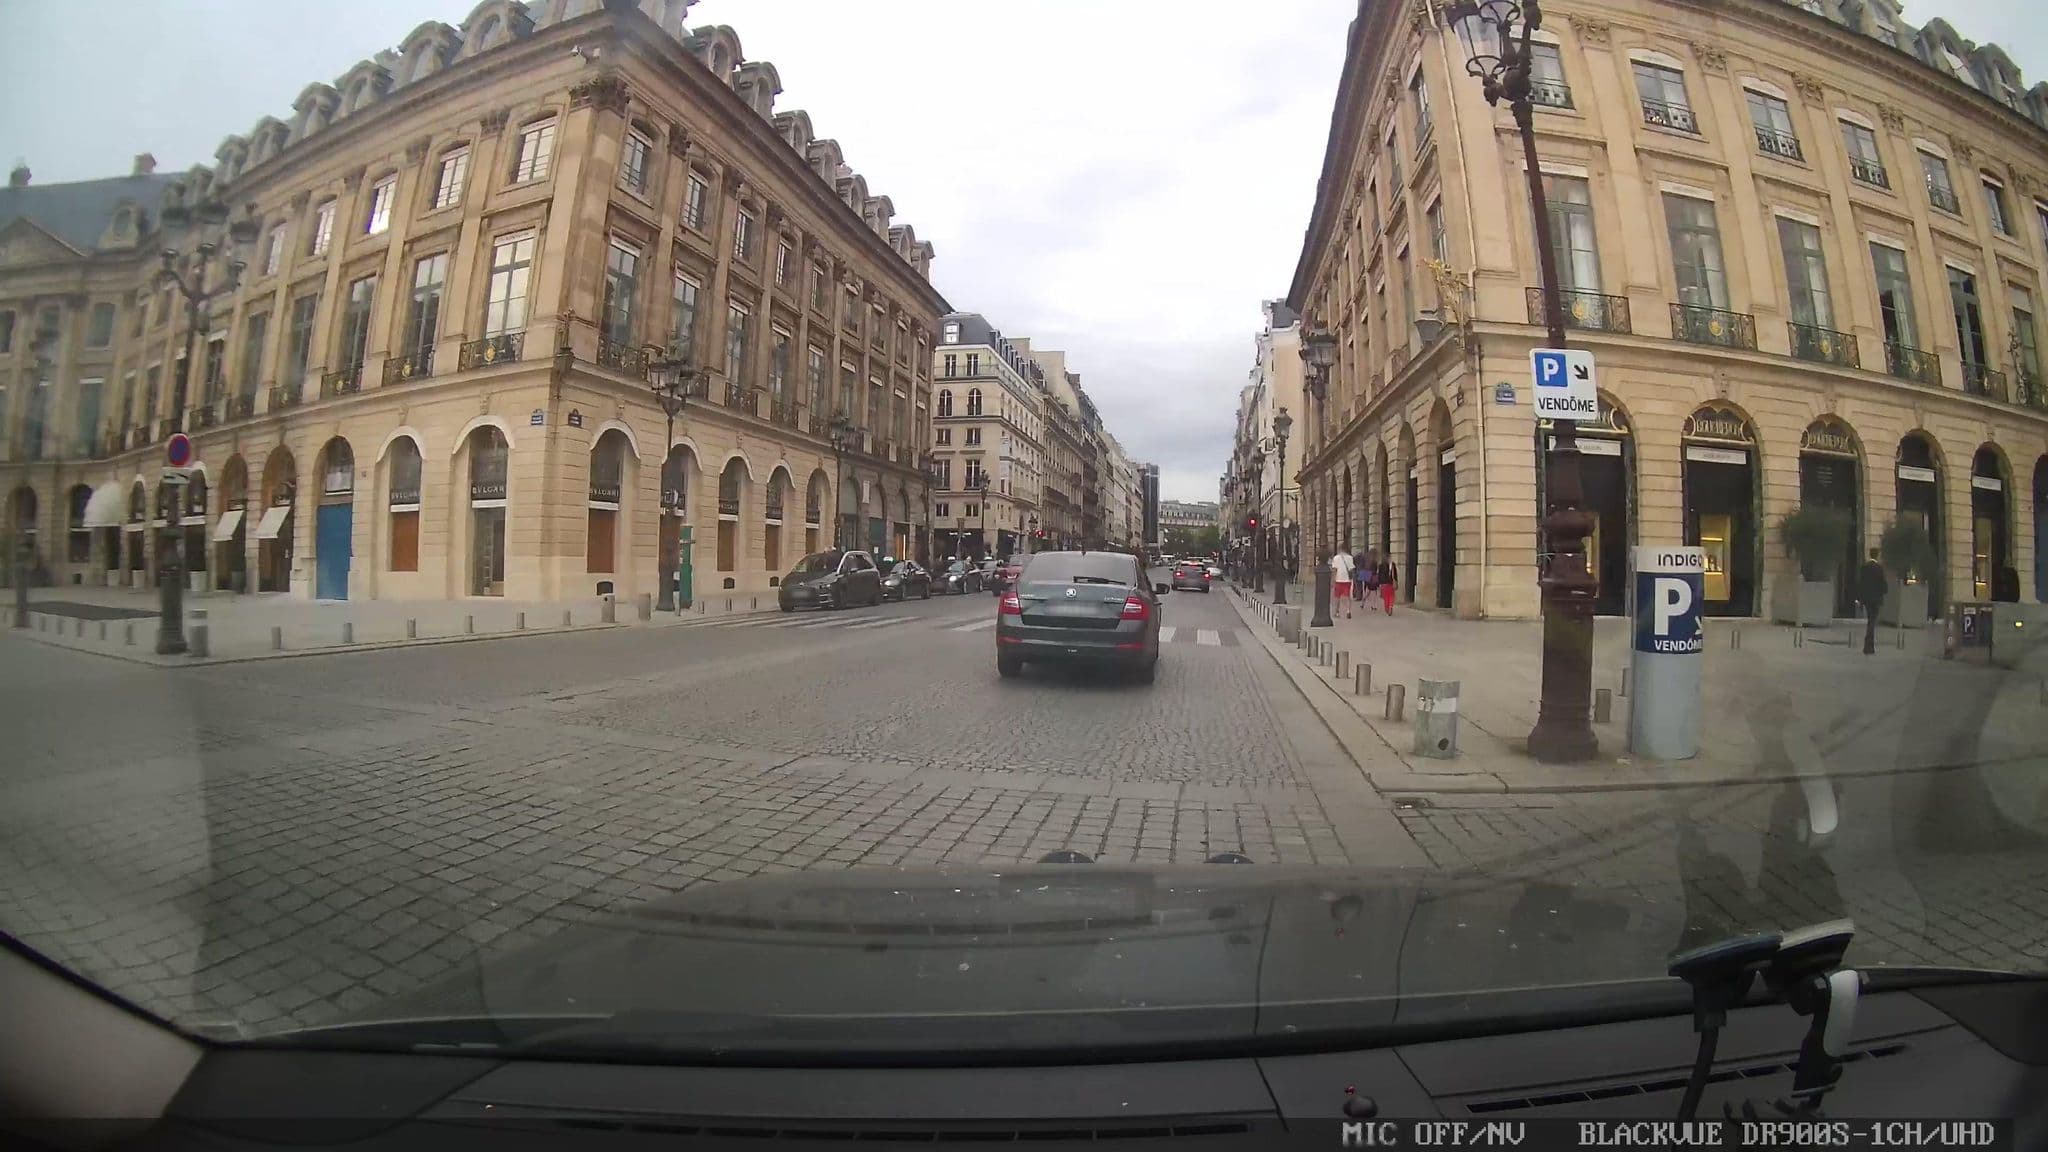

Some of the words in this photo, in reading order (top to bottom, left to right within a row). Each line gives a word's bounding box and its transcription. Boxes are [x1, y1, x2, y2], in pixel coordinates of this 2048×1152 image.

[1542, 357, 1560, 382] P
[1538, 396, 1596, 413] VENDÔME
[1654, 577, 1693, 636] P
